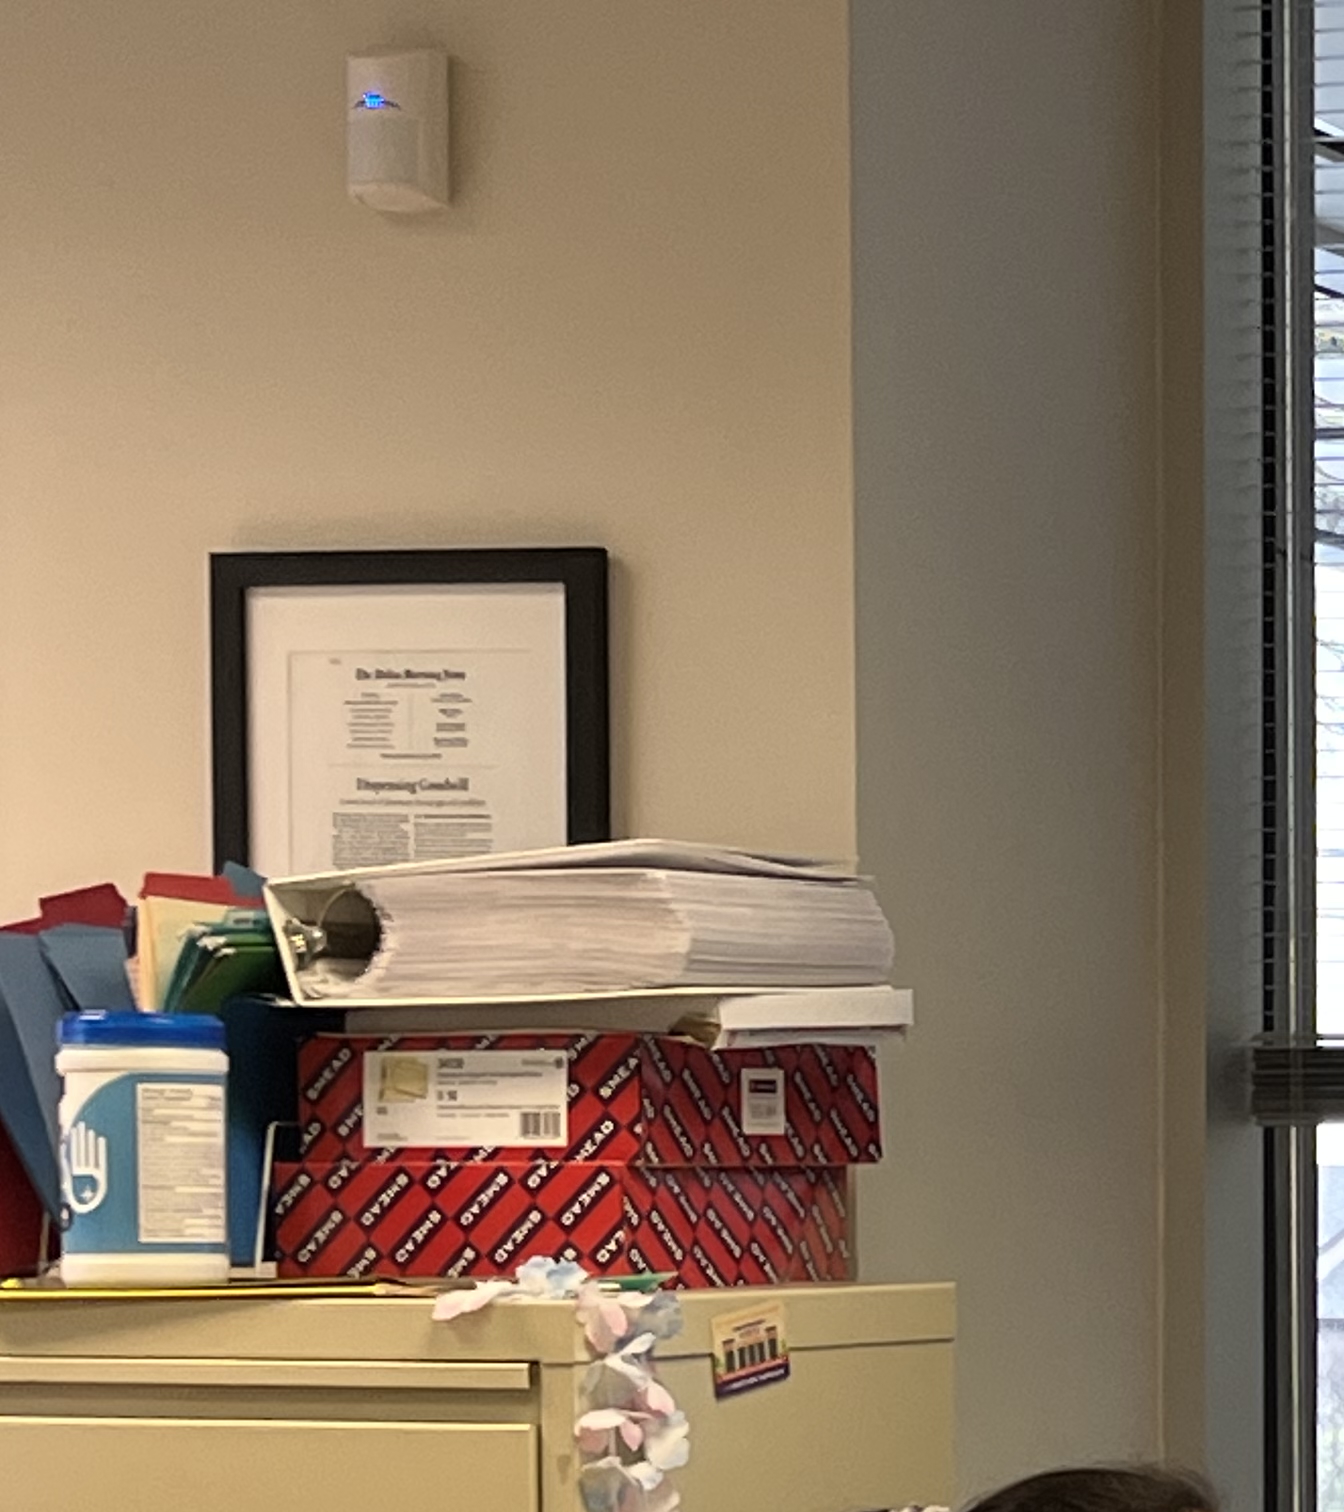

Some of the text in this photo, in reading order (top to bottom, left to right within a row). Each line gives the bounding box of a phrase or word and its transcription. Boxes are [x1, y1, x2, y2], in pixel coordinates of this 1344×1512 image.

[306, 1048, 351, 1100] SMEAD
[275, 1173, 311, 1215] SMEA
[360, 1173, 410, 1227] SMEAD
[460, 1172, 509, 1226] SMEAD
[561, 1172, 611, 1226] SMEAD
[297, 1210, 344, 1263] SMEAD
[395, 1210, 442, 1263] SMEAD
[494, 1210, 542, 1263] SMEAD
